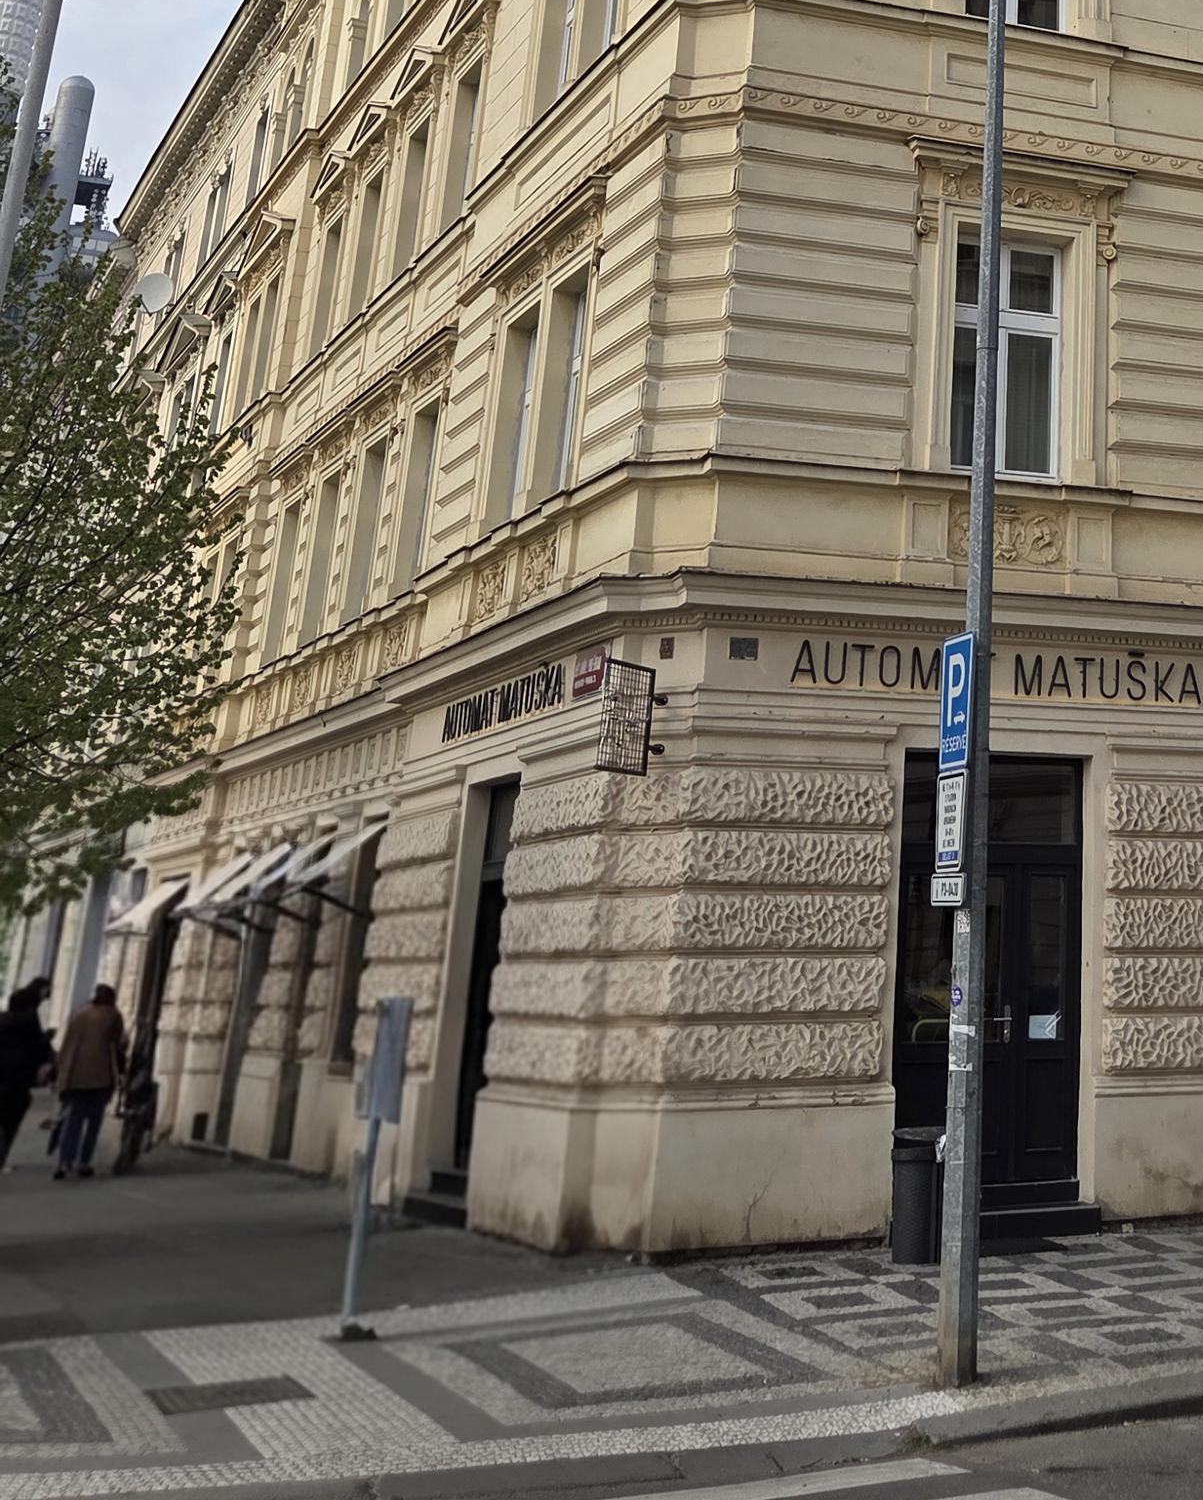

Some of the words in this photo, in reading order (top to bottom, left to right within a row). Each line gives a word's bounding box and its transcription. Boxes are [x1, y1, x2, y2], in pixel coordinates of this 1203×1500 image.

[791, 639, 995, 689] AUTOM
[1013, 651, 1203, 704] MATUŠKA
[947, 653, 965, 727] P
